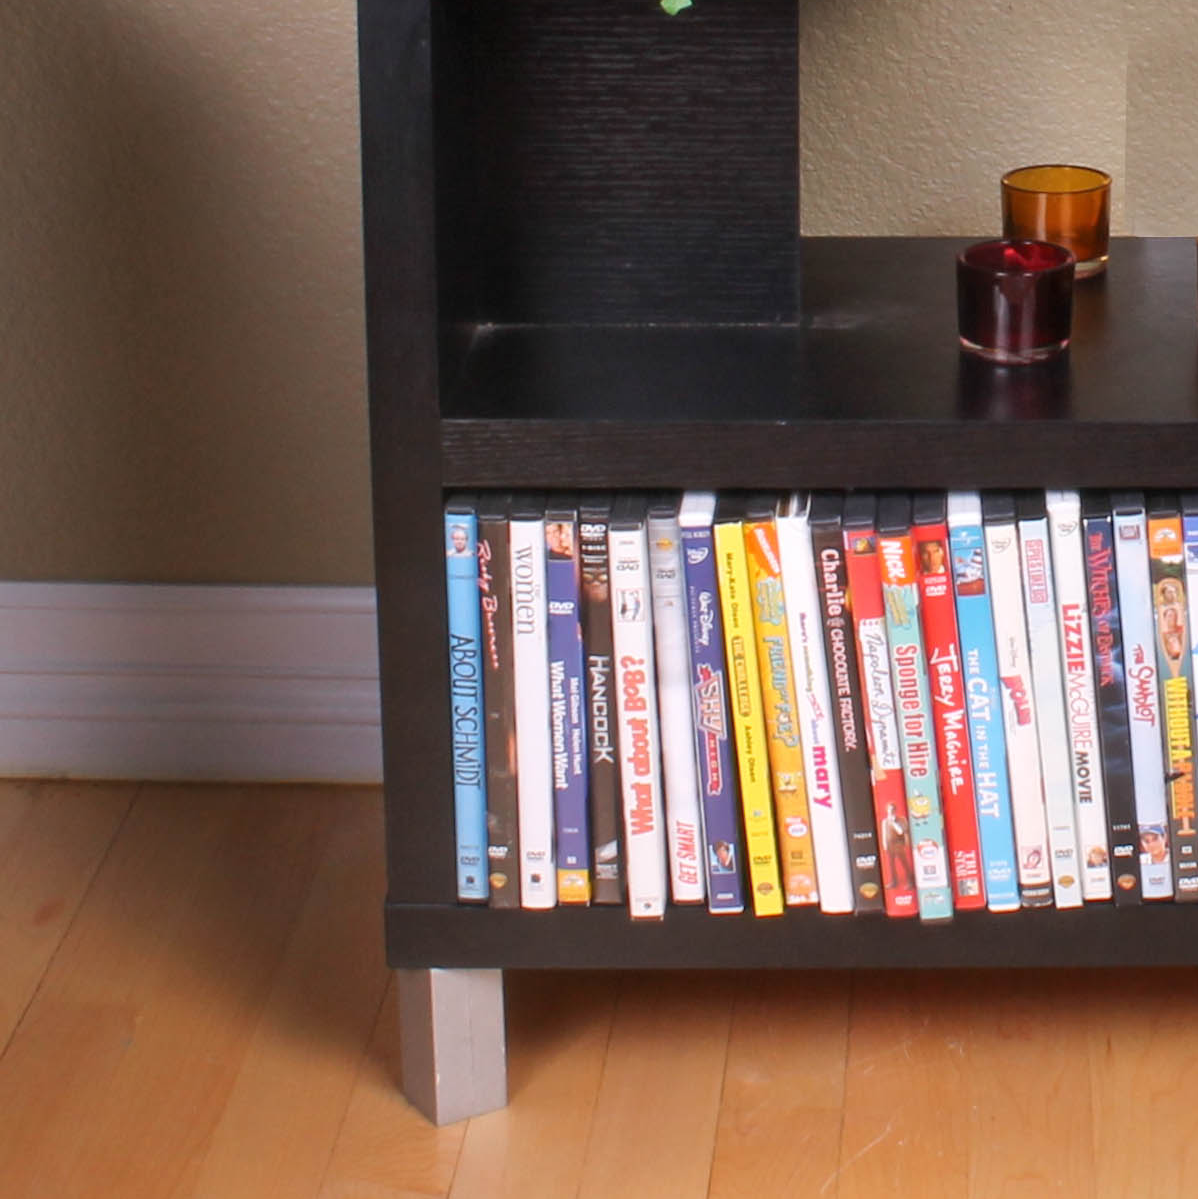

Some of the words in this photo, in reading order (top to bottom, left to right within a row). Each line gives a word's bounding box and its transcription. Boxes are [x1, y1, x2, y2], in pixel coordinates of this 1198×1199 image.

[514, 546, 535, 635] women
[821, 548, 844, 616] Charlie
[450, 634, 479, 701] ABOUT
[551, 661, 565, 698] What
[831, 628, 850, 694] CHOCOLATE
[894, 644, 920, 710] Sponge
[968, 650, 980, 675] THE
[589, 655, 614, 764] HANCOCK
[968, 678, 990, 721] CAT
[552, 700, 567, 752] Women
[904, 713, 926, 738] for
[555, 753, 569, 789] Want
[813, 746, 833, 809] mary
[907, 740, 930, 777] Hire
[978, 744, 990, 769] THE
[1075, 751, 1092, 803] MOVIE
[977, 773, 999, 817] HAT
[676, 821, 697, 861] SMART
[678, 863, 698, 885] GET
